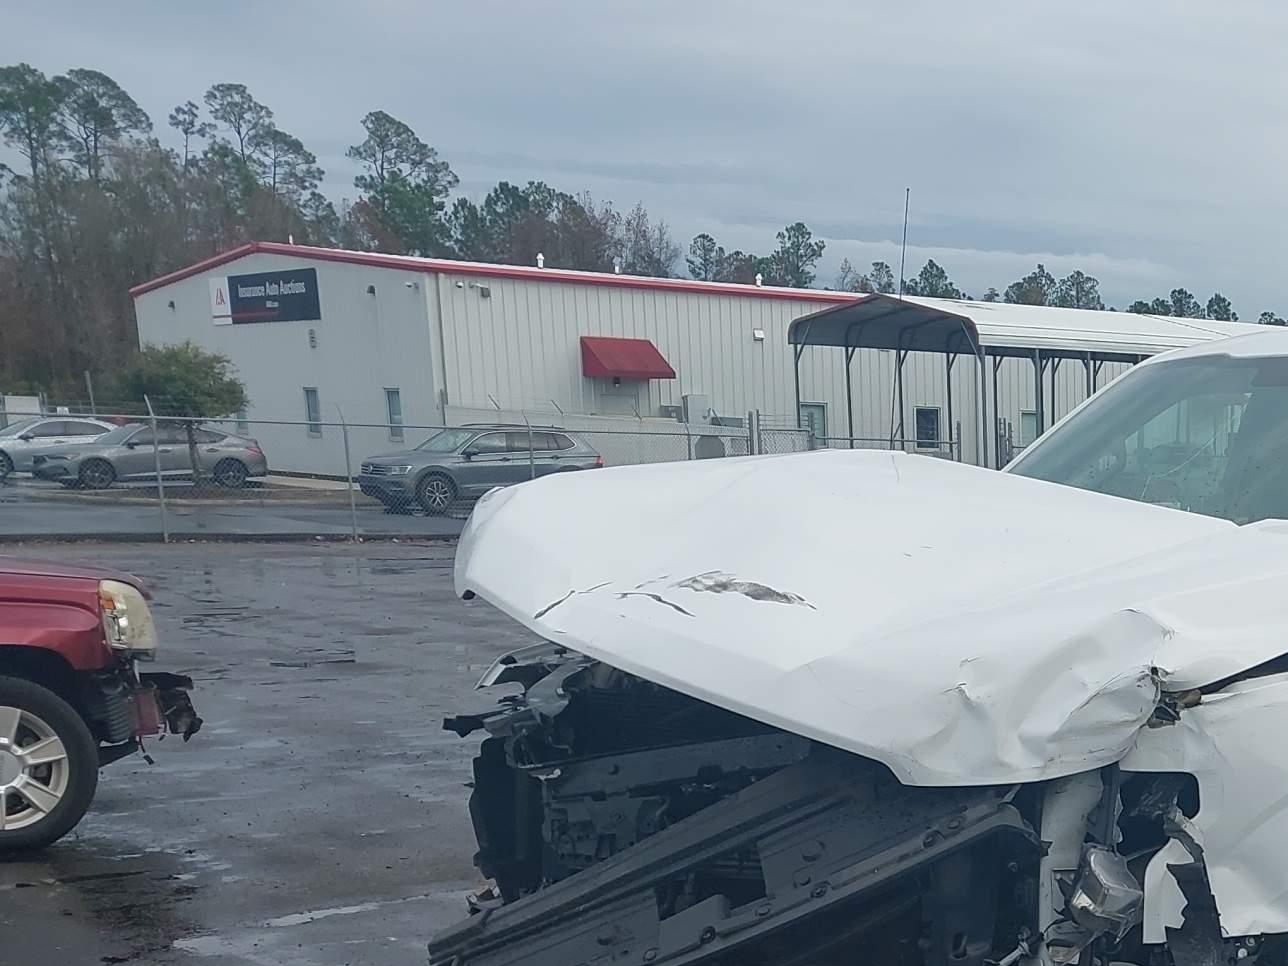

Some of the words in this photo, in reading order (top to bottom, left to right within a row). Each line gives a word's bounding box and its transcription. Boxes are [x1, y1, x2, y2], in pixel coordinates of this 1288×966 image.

[238, 284, 265, 298] Insurance
[266, 281, 279, 295] Auto
[280, 279, 306, 295] Auctions
